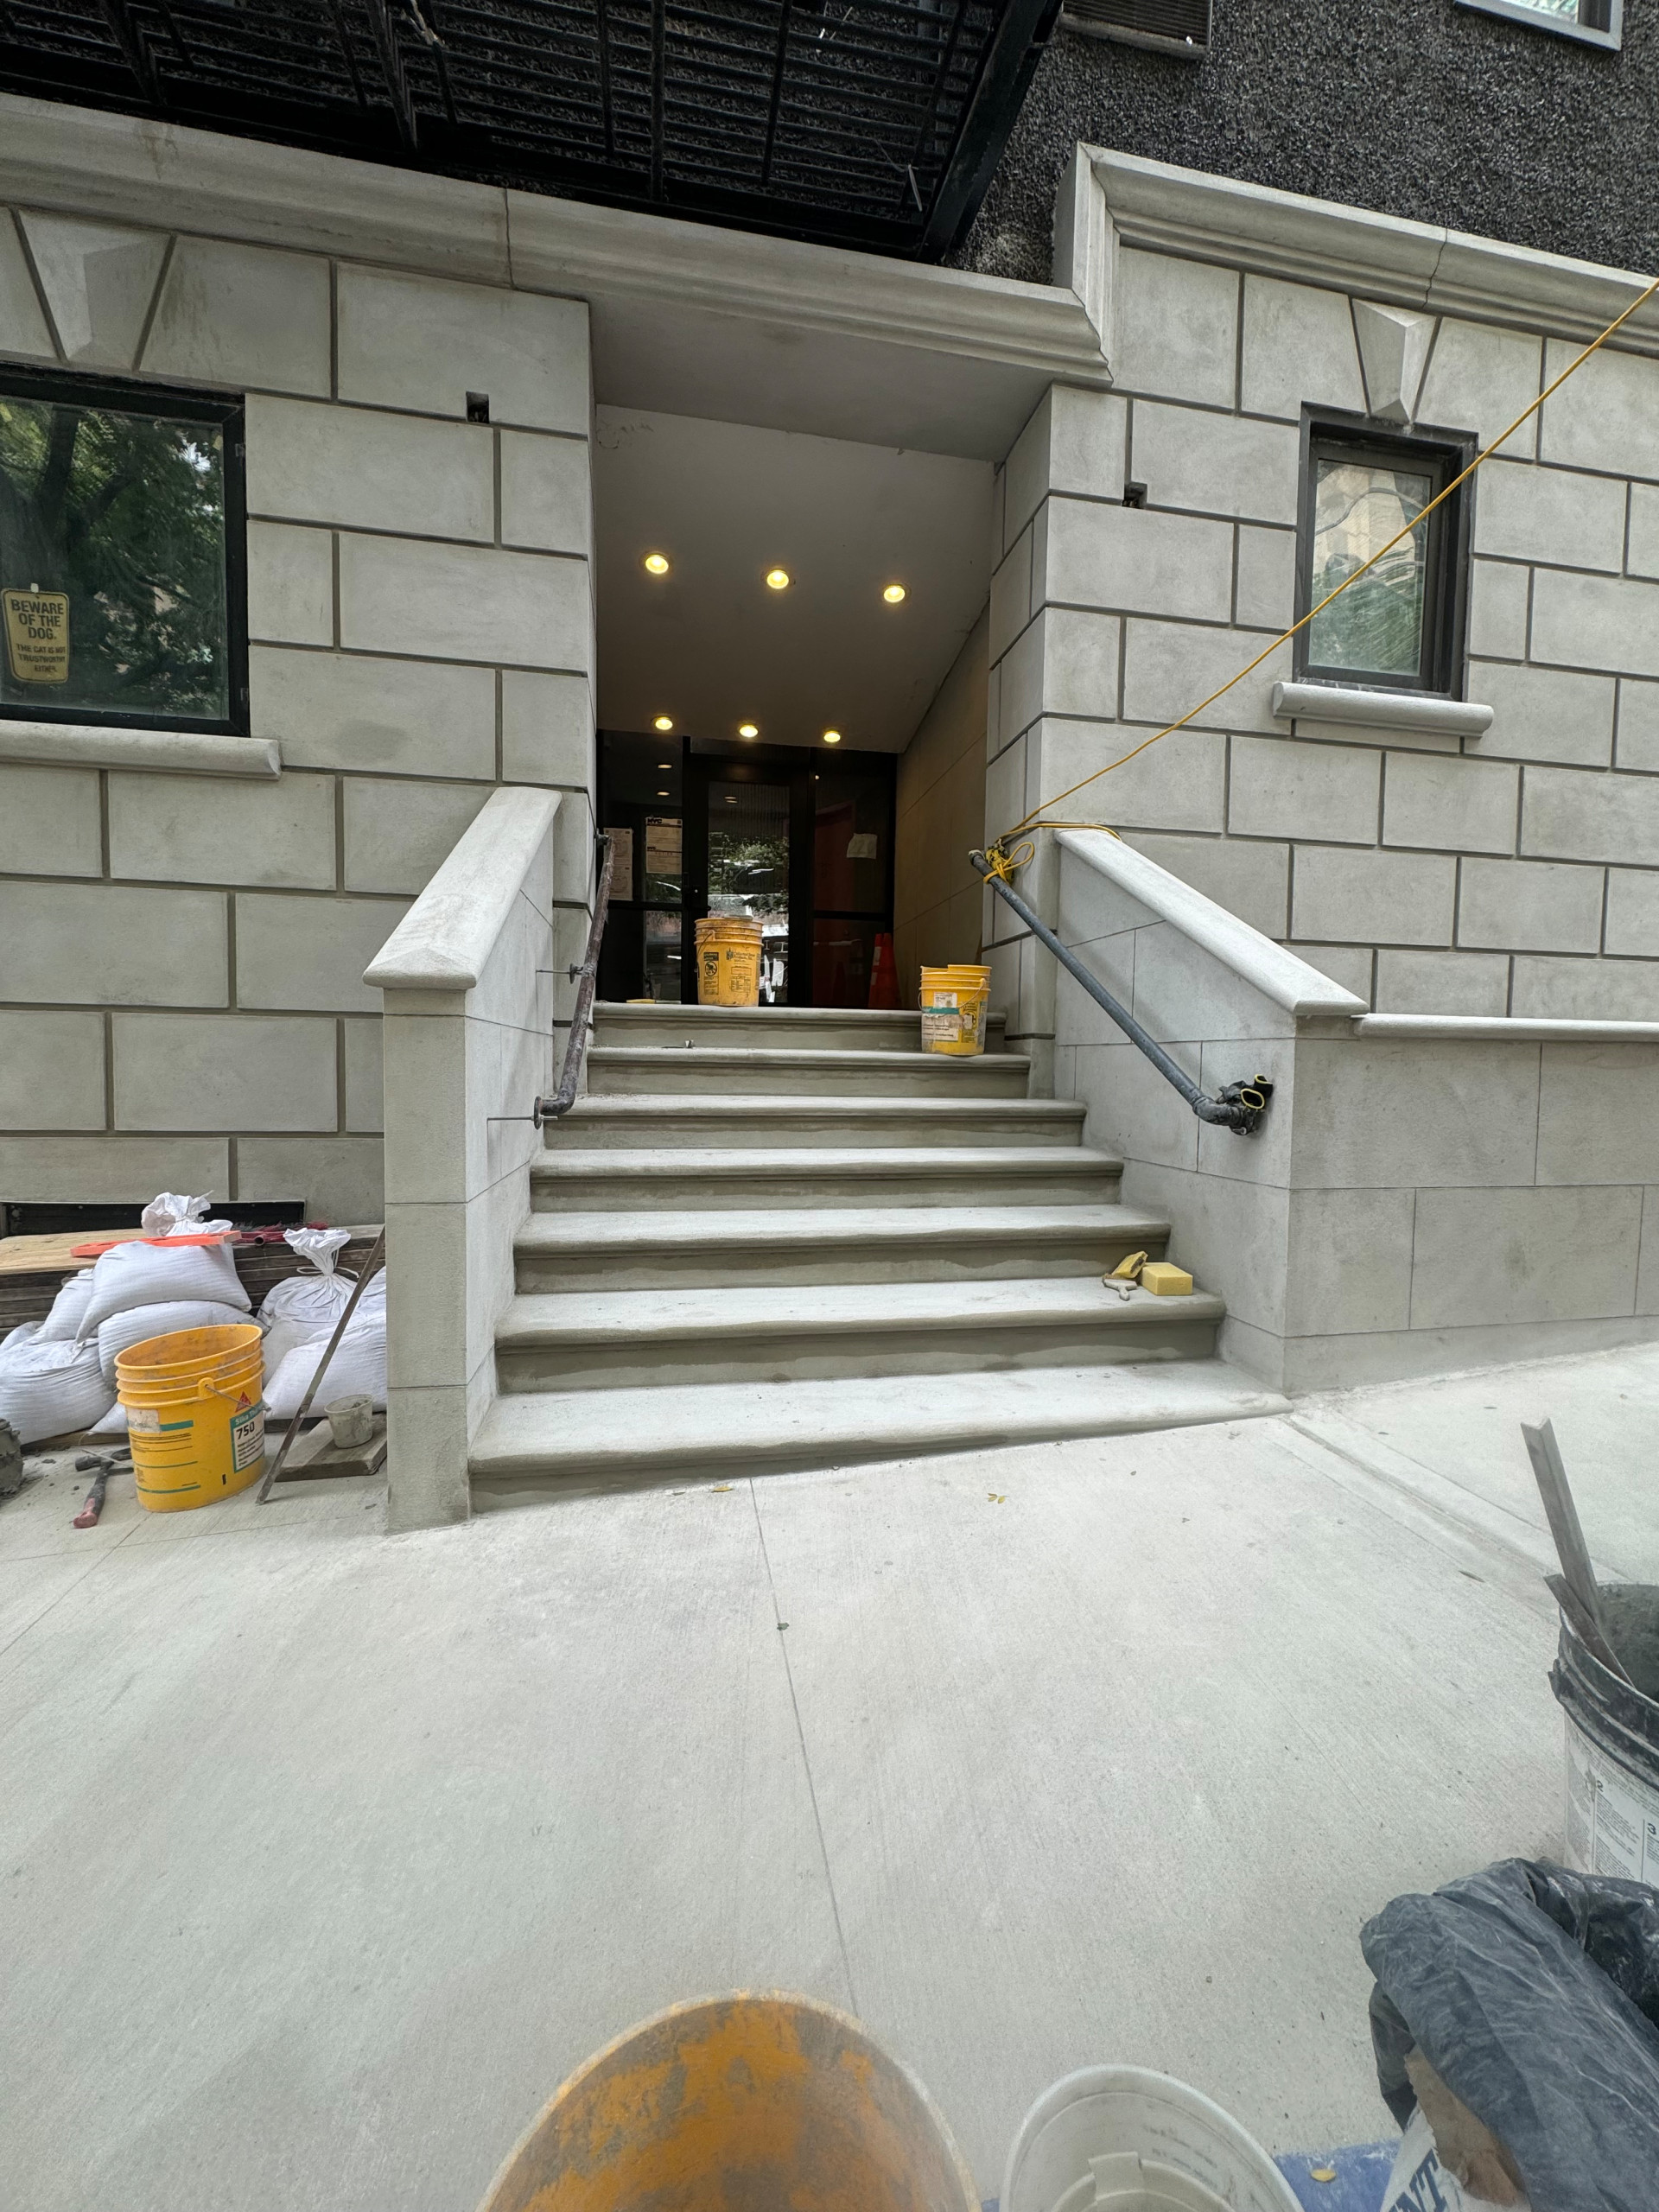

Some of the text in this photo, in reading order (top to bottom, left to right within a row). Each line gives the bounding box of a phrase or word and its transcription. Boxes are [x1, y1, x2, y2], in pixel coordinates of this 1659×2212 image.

[11, 599, 64, 614] BEWARE
[19, 613, 61, 627] OF THE
[29, 626, 56, 639] DOG.
[16, 644, 31, 652] THE
[236, 1421, 255, 1440] 750
